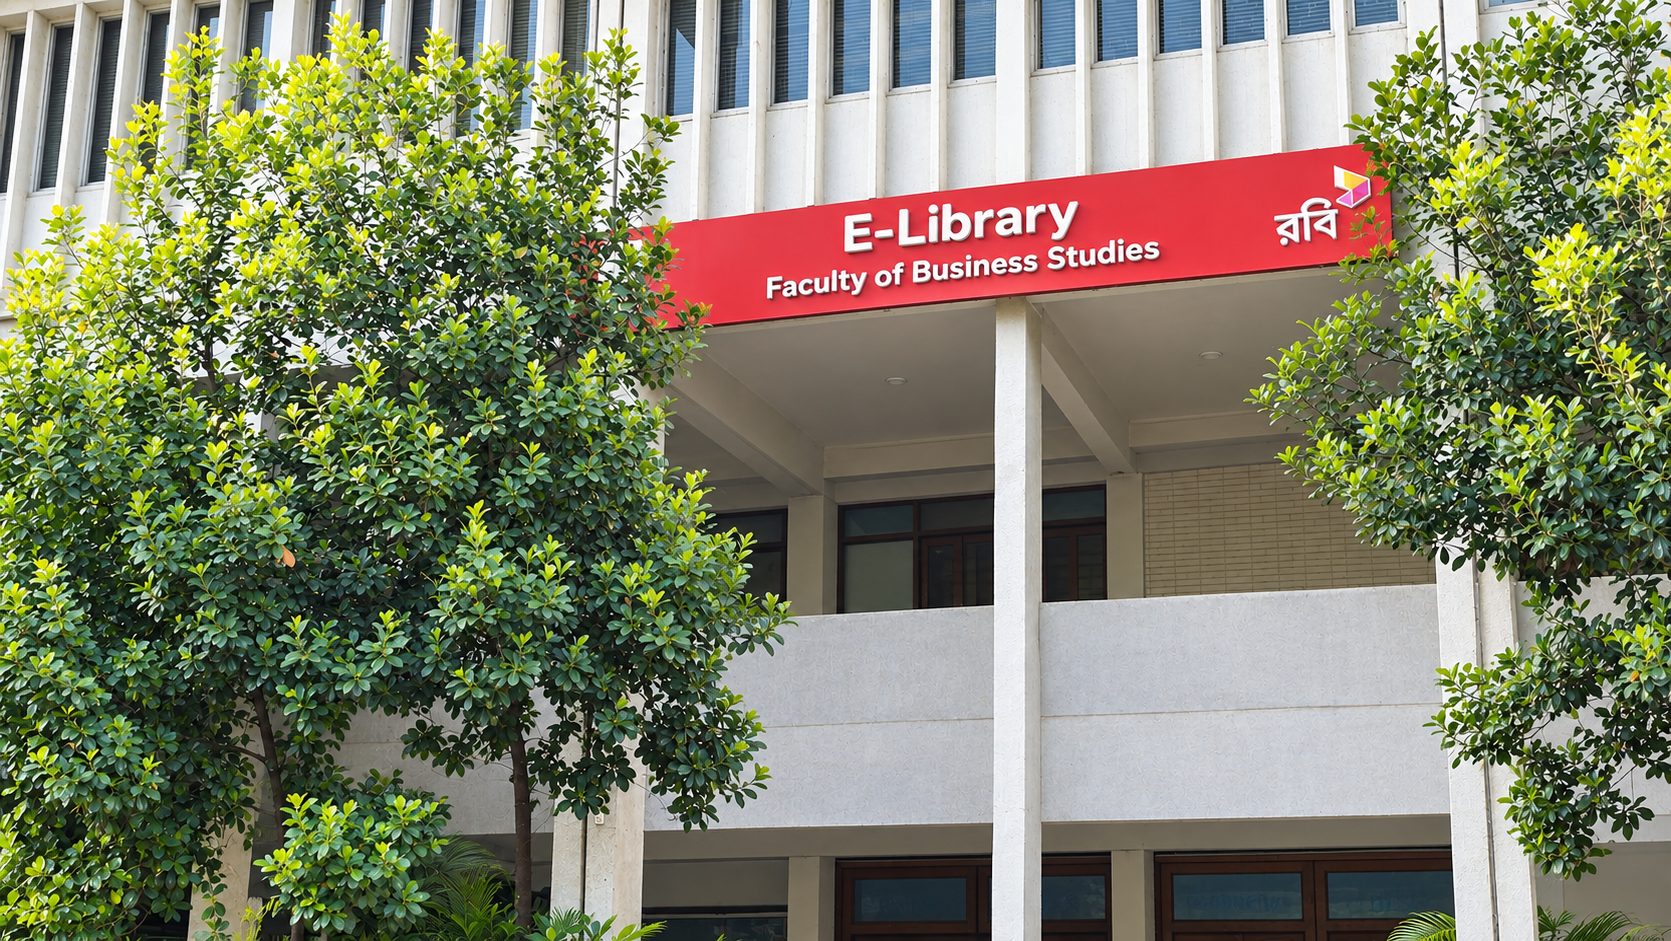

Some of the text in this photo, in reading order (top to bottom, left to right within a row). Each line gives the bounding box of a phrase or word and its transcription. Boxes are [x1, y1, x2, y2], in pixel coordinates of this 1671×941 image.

[844, 200, 1079, 254] E-Library
[1274, 197, 1339, 246] রবি
[767, 238, 1160, 300] Faculty of Business Studies
